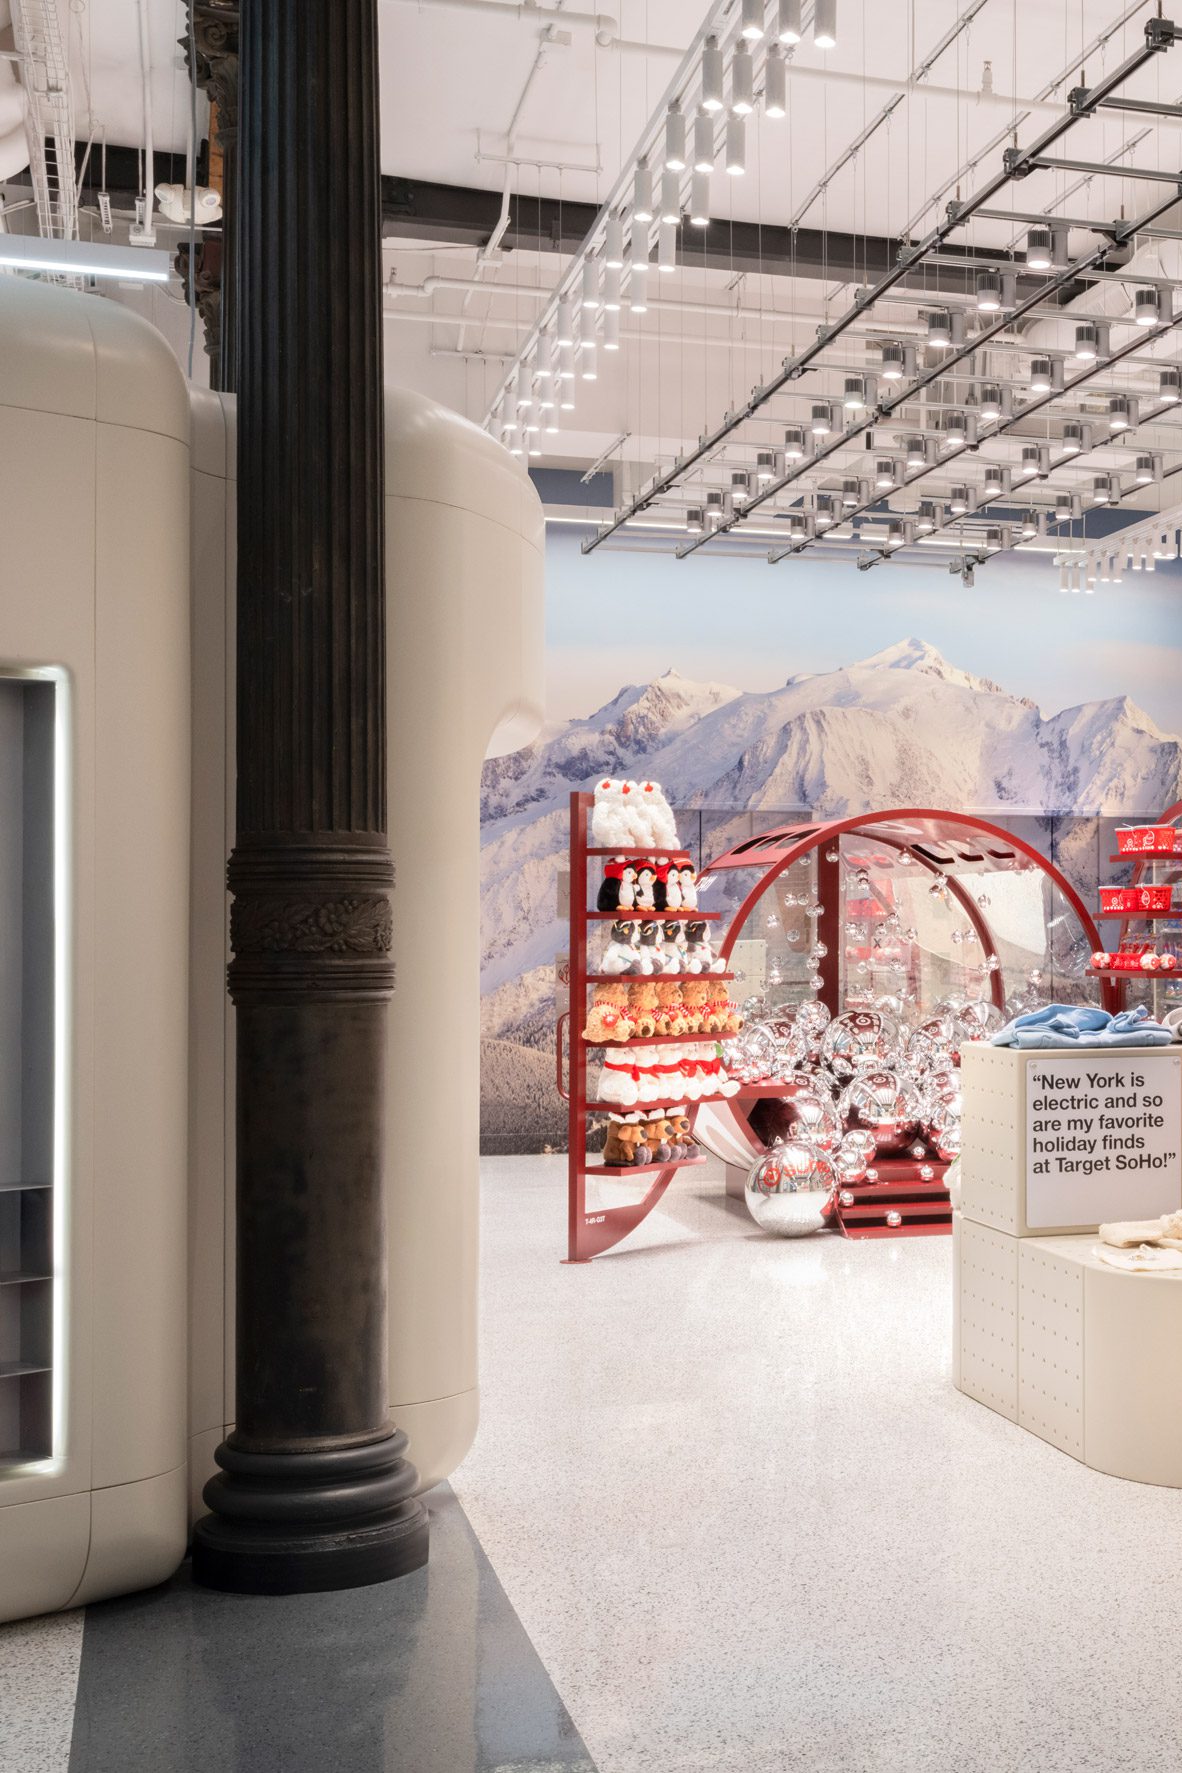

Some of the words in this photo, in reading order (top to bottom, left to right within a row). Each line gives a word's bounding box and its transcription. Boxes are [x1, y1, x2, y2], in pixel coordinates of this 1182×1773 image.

[1033, 1074, 1081, 1090] “New
[1086, 1072, 1125, 1089] York
[1130, 1072, 1145, 1088] is
[1032, 1094, 1099, 1111] electric
[1104, 1092, 1137, 1109] and
[1142, 1094, 1163, 1107] so
[1032, 1119, 1062, 1132] are
[1067, 1117, 1094, 1134] my
[1099, 1113, 1165, 1130] favorite
[1032, 1136, 1097, 1154] holiday
[1102, 1134, 1145, 1150] finds
[1032, 1159, 1051, 1174] at
[1055, 1156, 1111, 1175] Target
[1115, 1152, 1176, 1171] SoHo!”
